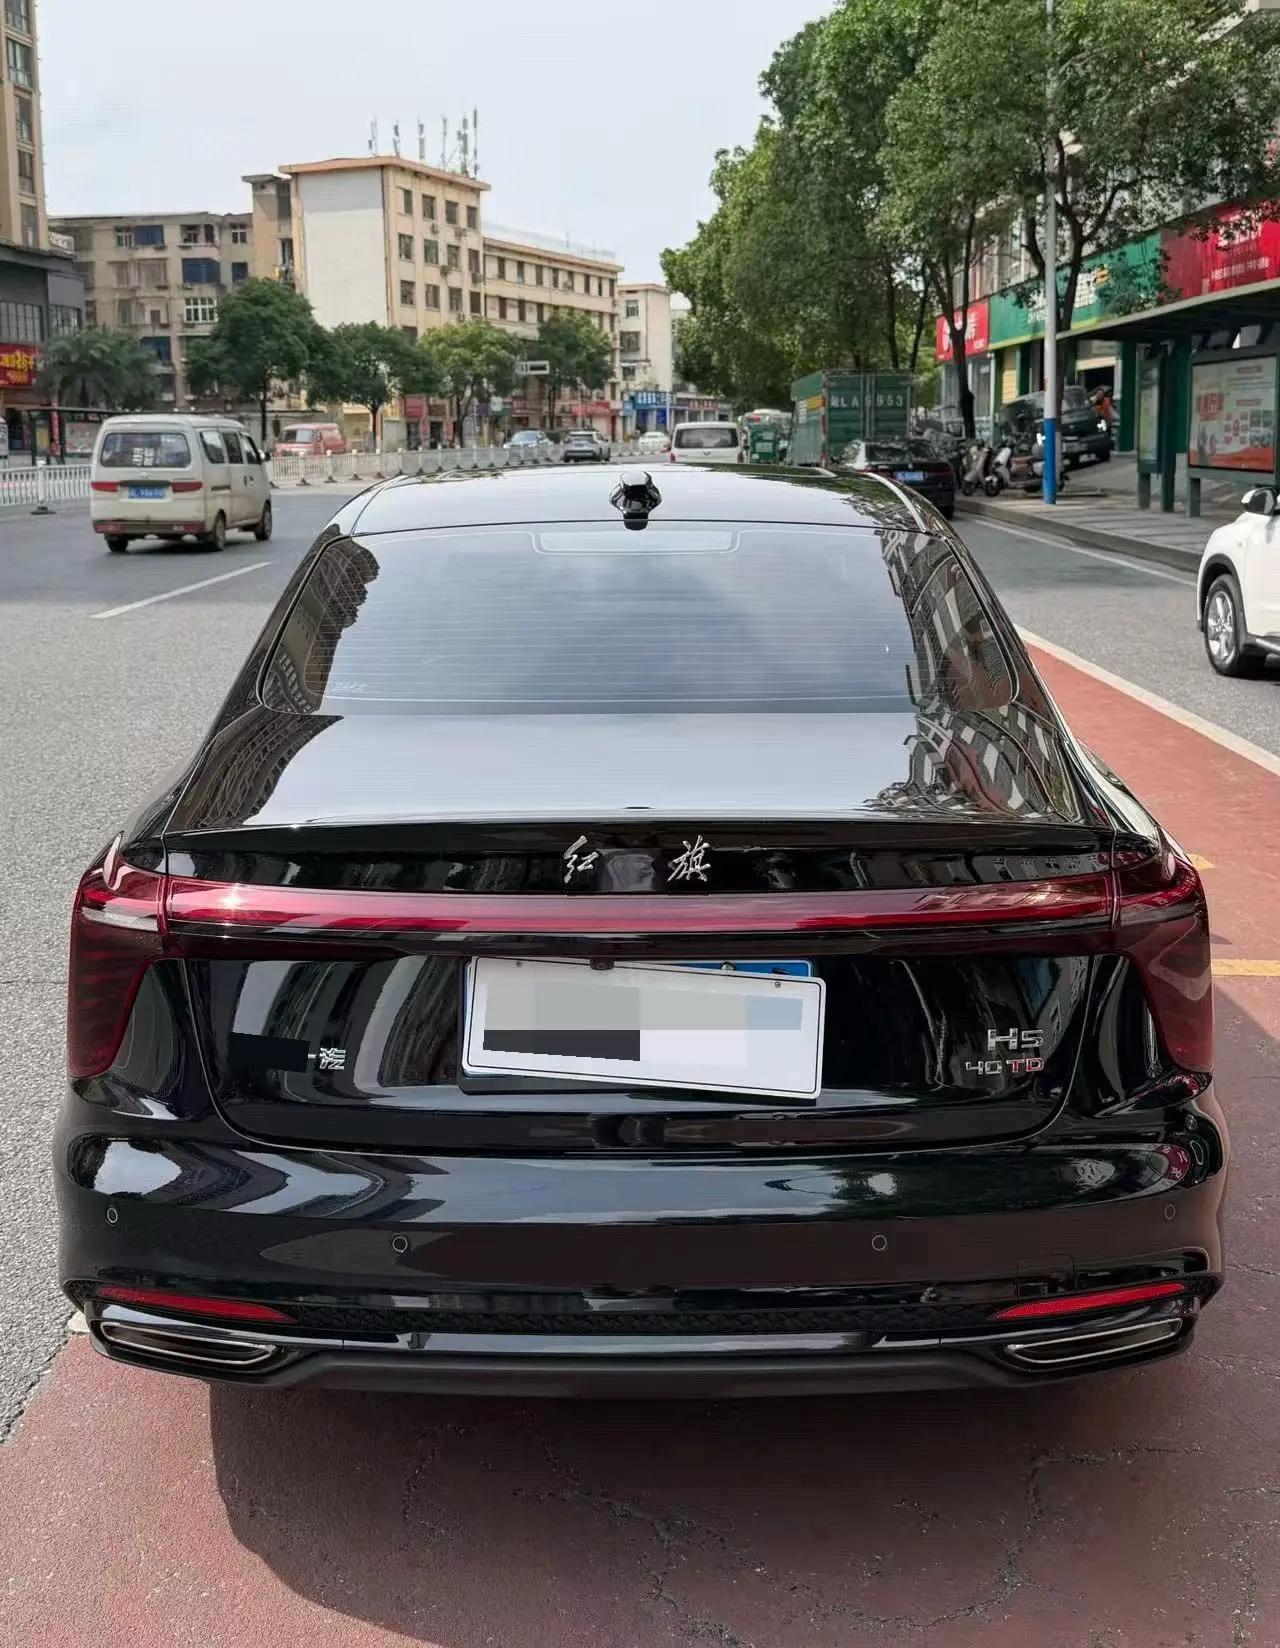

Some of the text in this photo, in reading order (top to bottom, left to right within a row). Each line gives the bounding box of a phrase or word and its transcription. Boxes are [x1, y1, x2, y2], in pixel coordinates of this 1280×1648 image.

[563, 834, 712, 884] 红旗
[987, 1027, 1044, 1051] H5
[965, 1057, 1045, 1075] 40TD
